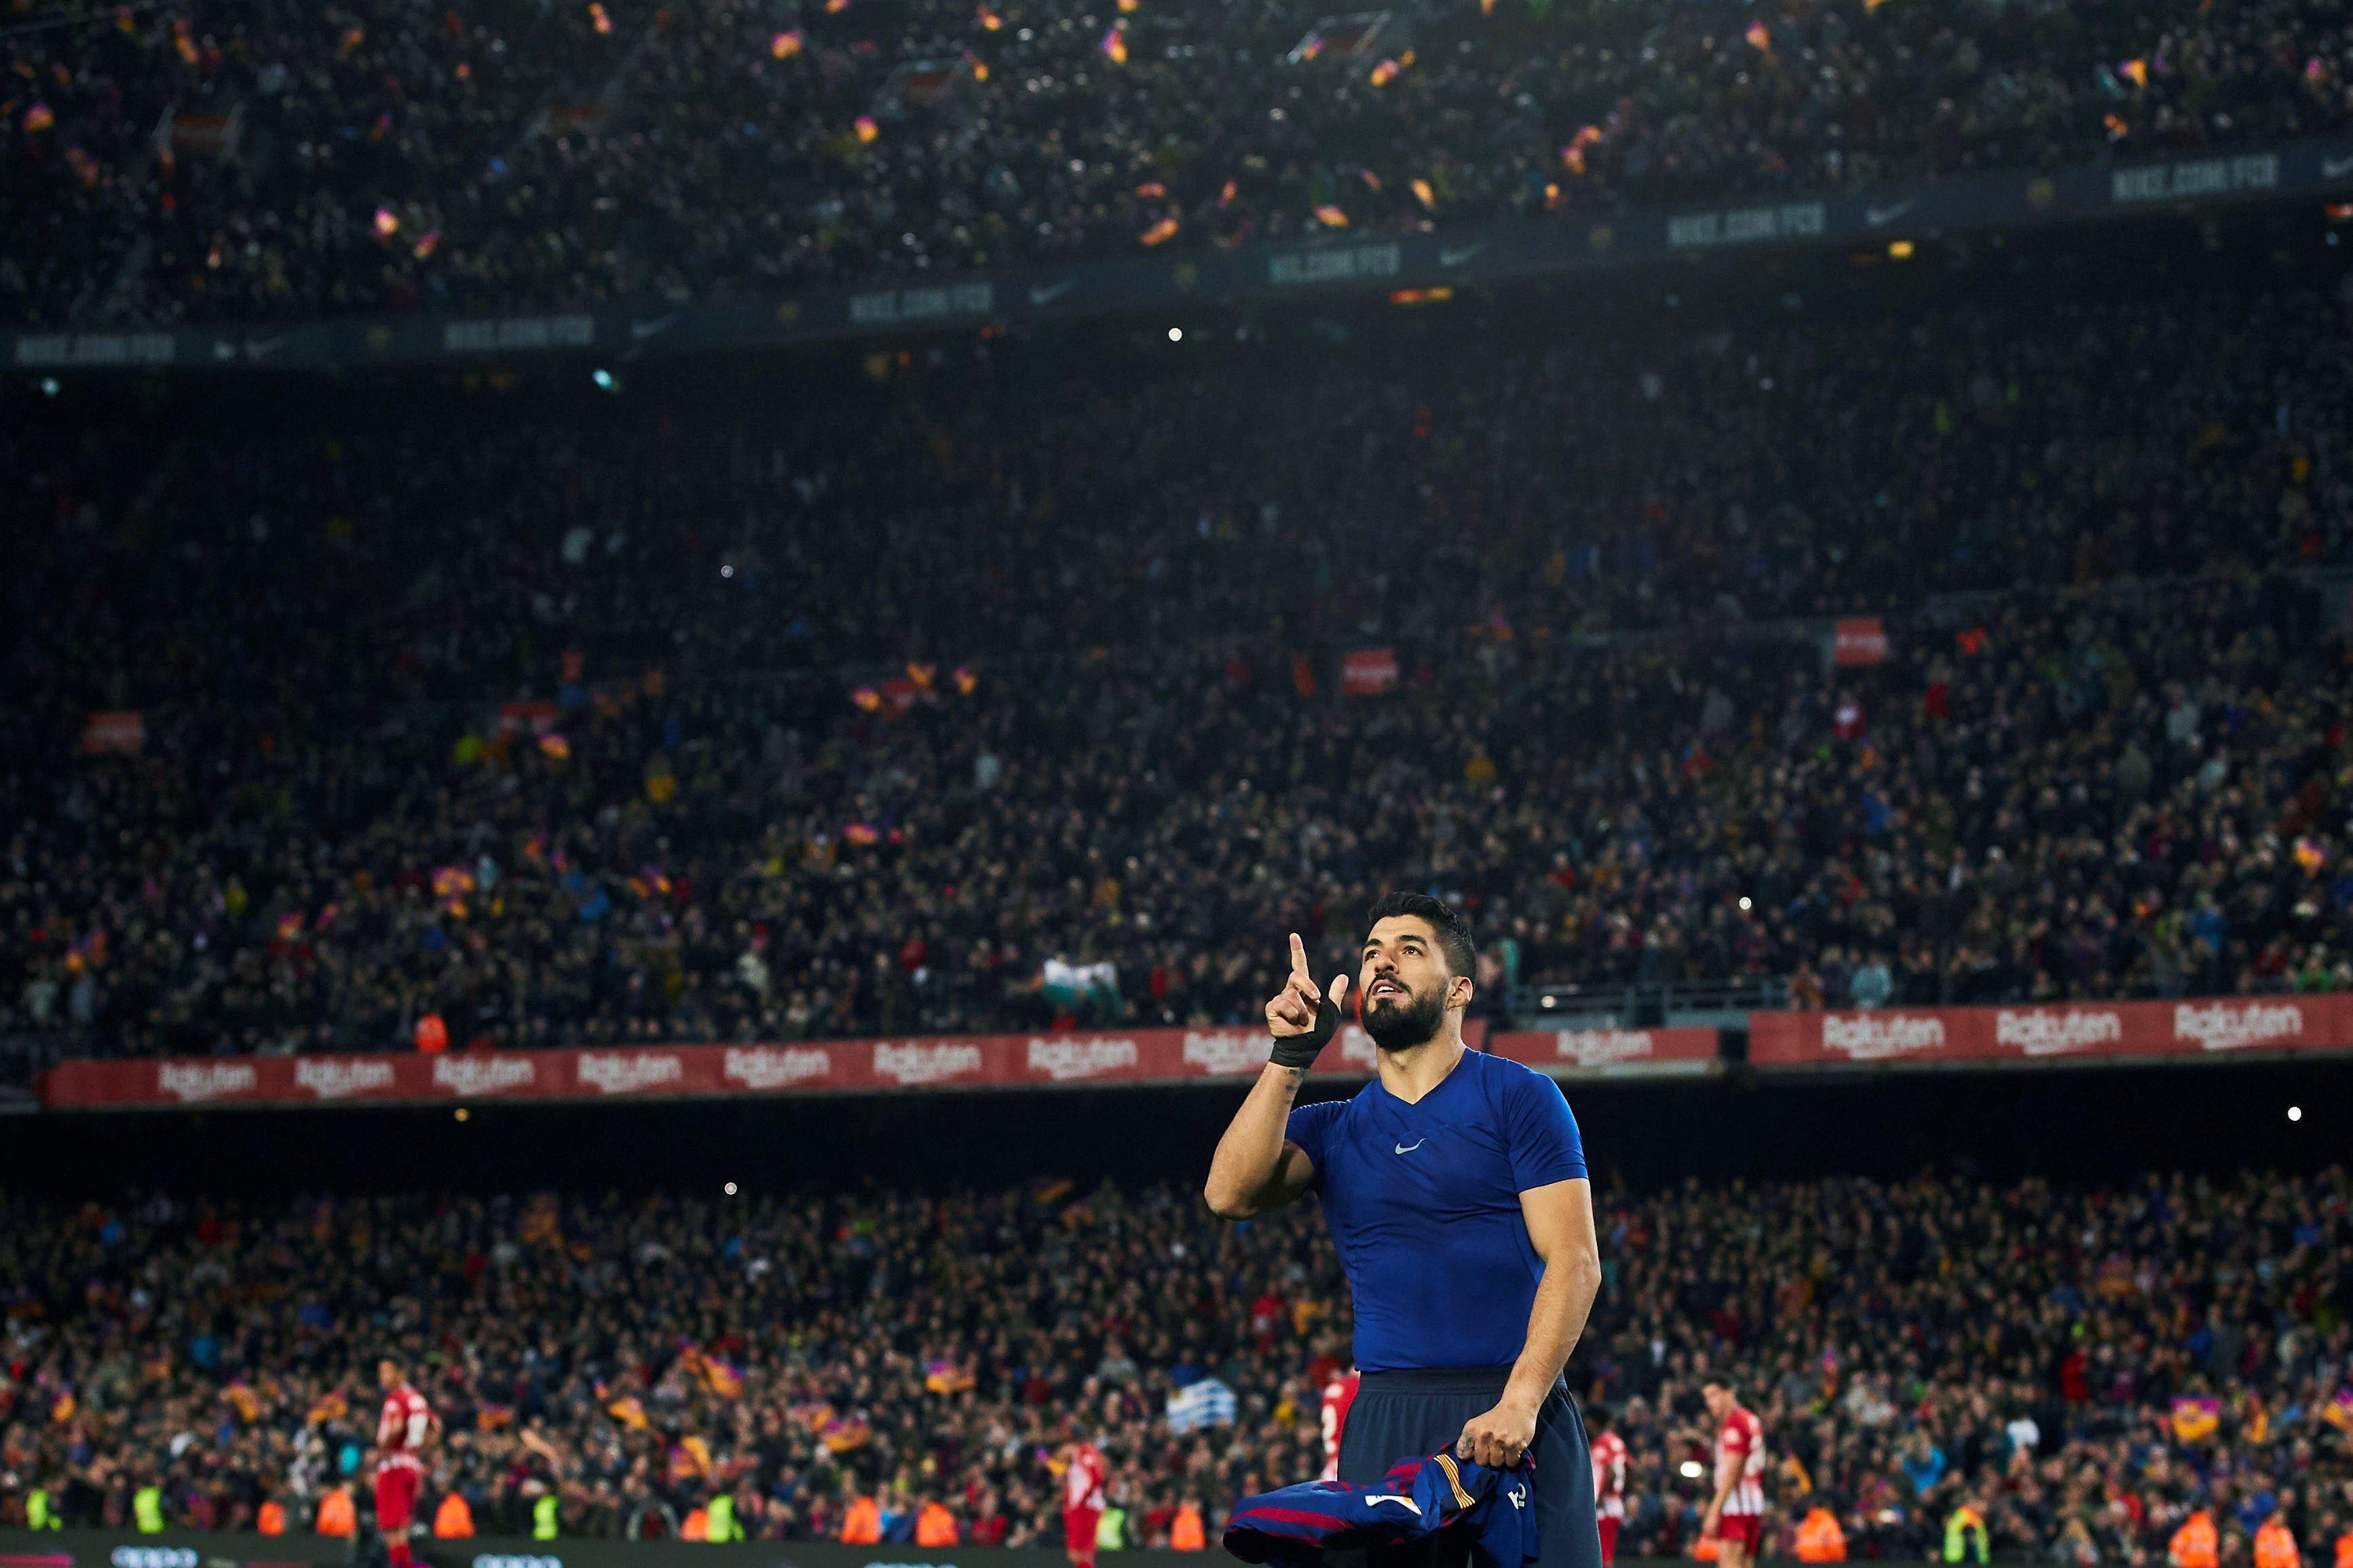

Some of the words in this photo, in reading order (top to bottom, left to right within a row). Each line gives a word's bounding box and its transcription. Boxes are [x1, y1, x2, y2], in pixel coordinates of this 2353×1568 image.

[1822, 1015, 1944, 1054] Rakuten
[1996, 1009, 2120, 1050] Rakuten
[2173, 1002, 2299, 1046] Rakuten
[873, 1042, 981, 1079] Rakuten
[1028, 1037, 1136, 1075] Rakuten
[1183, 1032, 1273, 1070] Rakute
[1556, 1029, 1651, 1061] Rakuten
[158, 1061, 257, 1097] Rakuten
[295, 1058, 394, 1094] Rakuten
[432, 1055, 534, 1092] Rakuten
[578, 1051, 681, 1089] Rakuten
[725, 1047, 828, 1085] Rakuten
